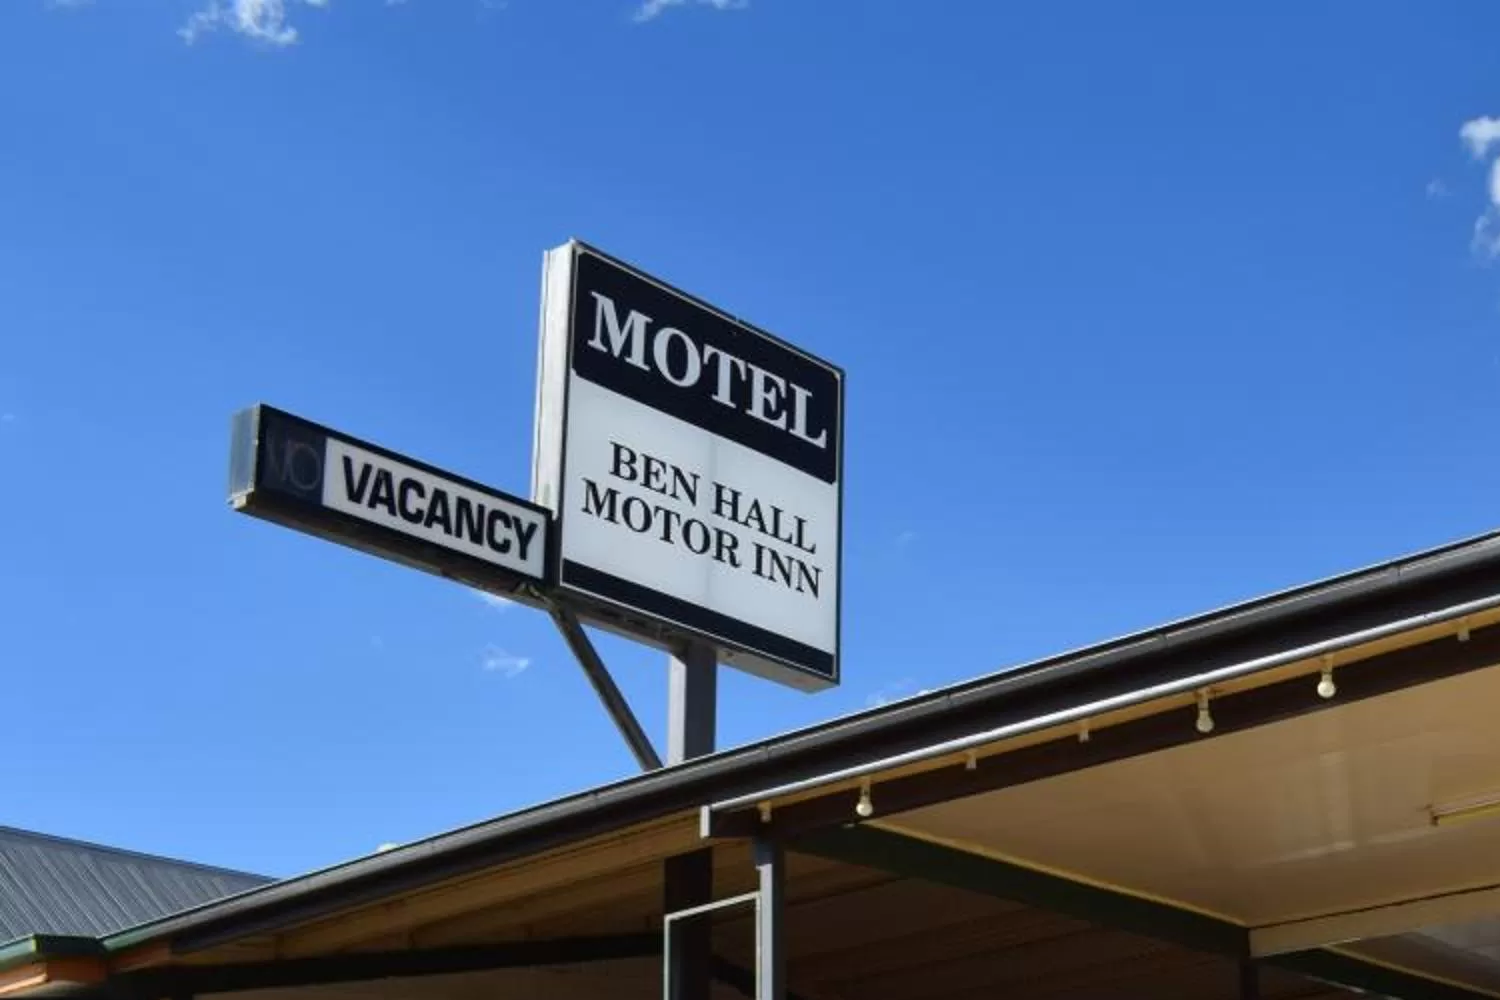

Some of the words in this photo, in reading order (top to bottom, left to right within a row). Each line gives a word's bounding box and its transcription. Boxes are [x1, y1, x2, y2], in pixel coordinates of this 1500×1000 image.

[587, 290, 827, 449] MOTEL
[343, 455, 538, 561] VACANCY
[581, 477, 741, 568] MOTOR
[752, 542, 823, 600] INN
[609, 441, 700, 507] BEN
[712, 481, 816, 554] HALL
